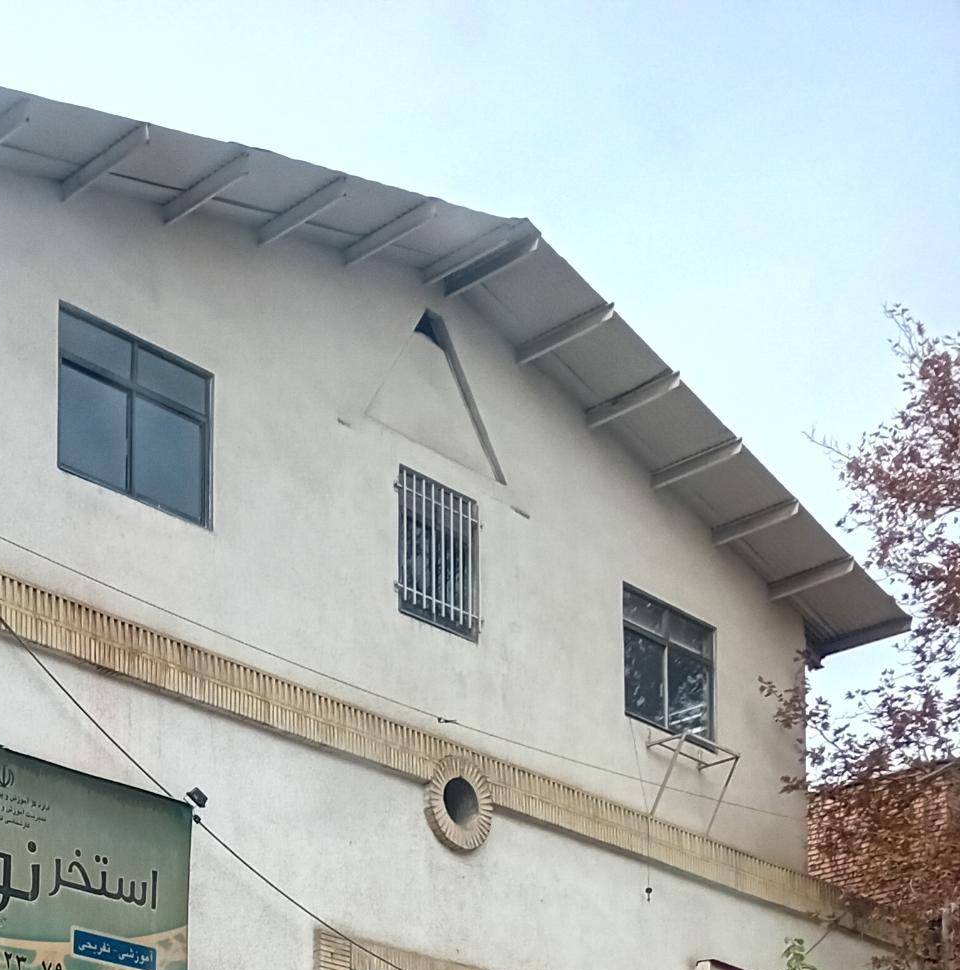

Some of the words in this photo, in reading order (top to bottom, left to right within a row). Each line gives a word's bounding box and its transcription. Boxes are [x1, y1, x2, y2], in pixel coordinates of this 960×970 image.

[48, 848, 159, 910] استخر
[78, 941, 112, 956] تفریحی
[118, 947, 154, 965] آموزشی
